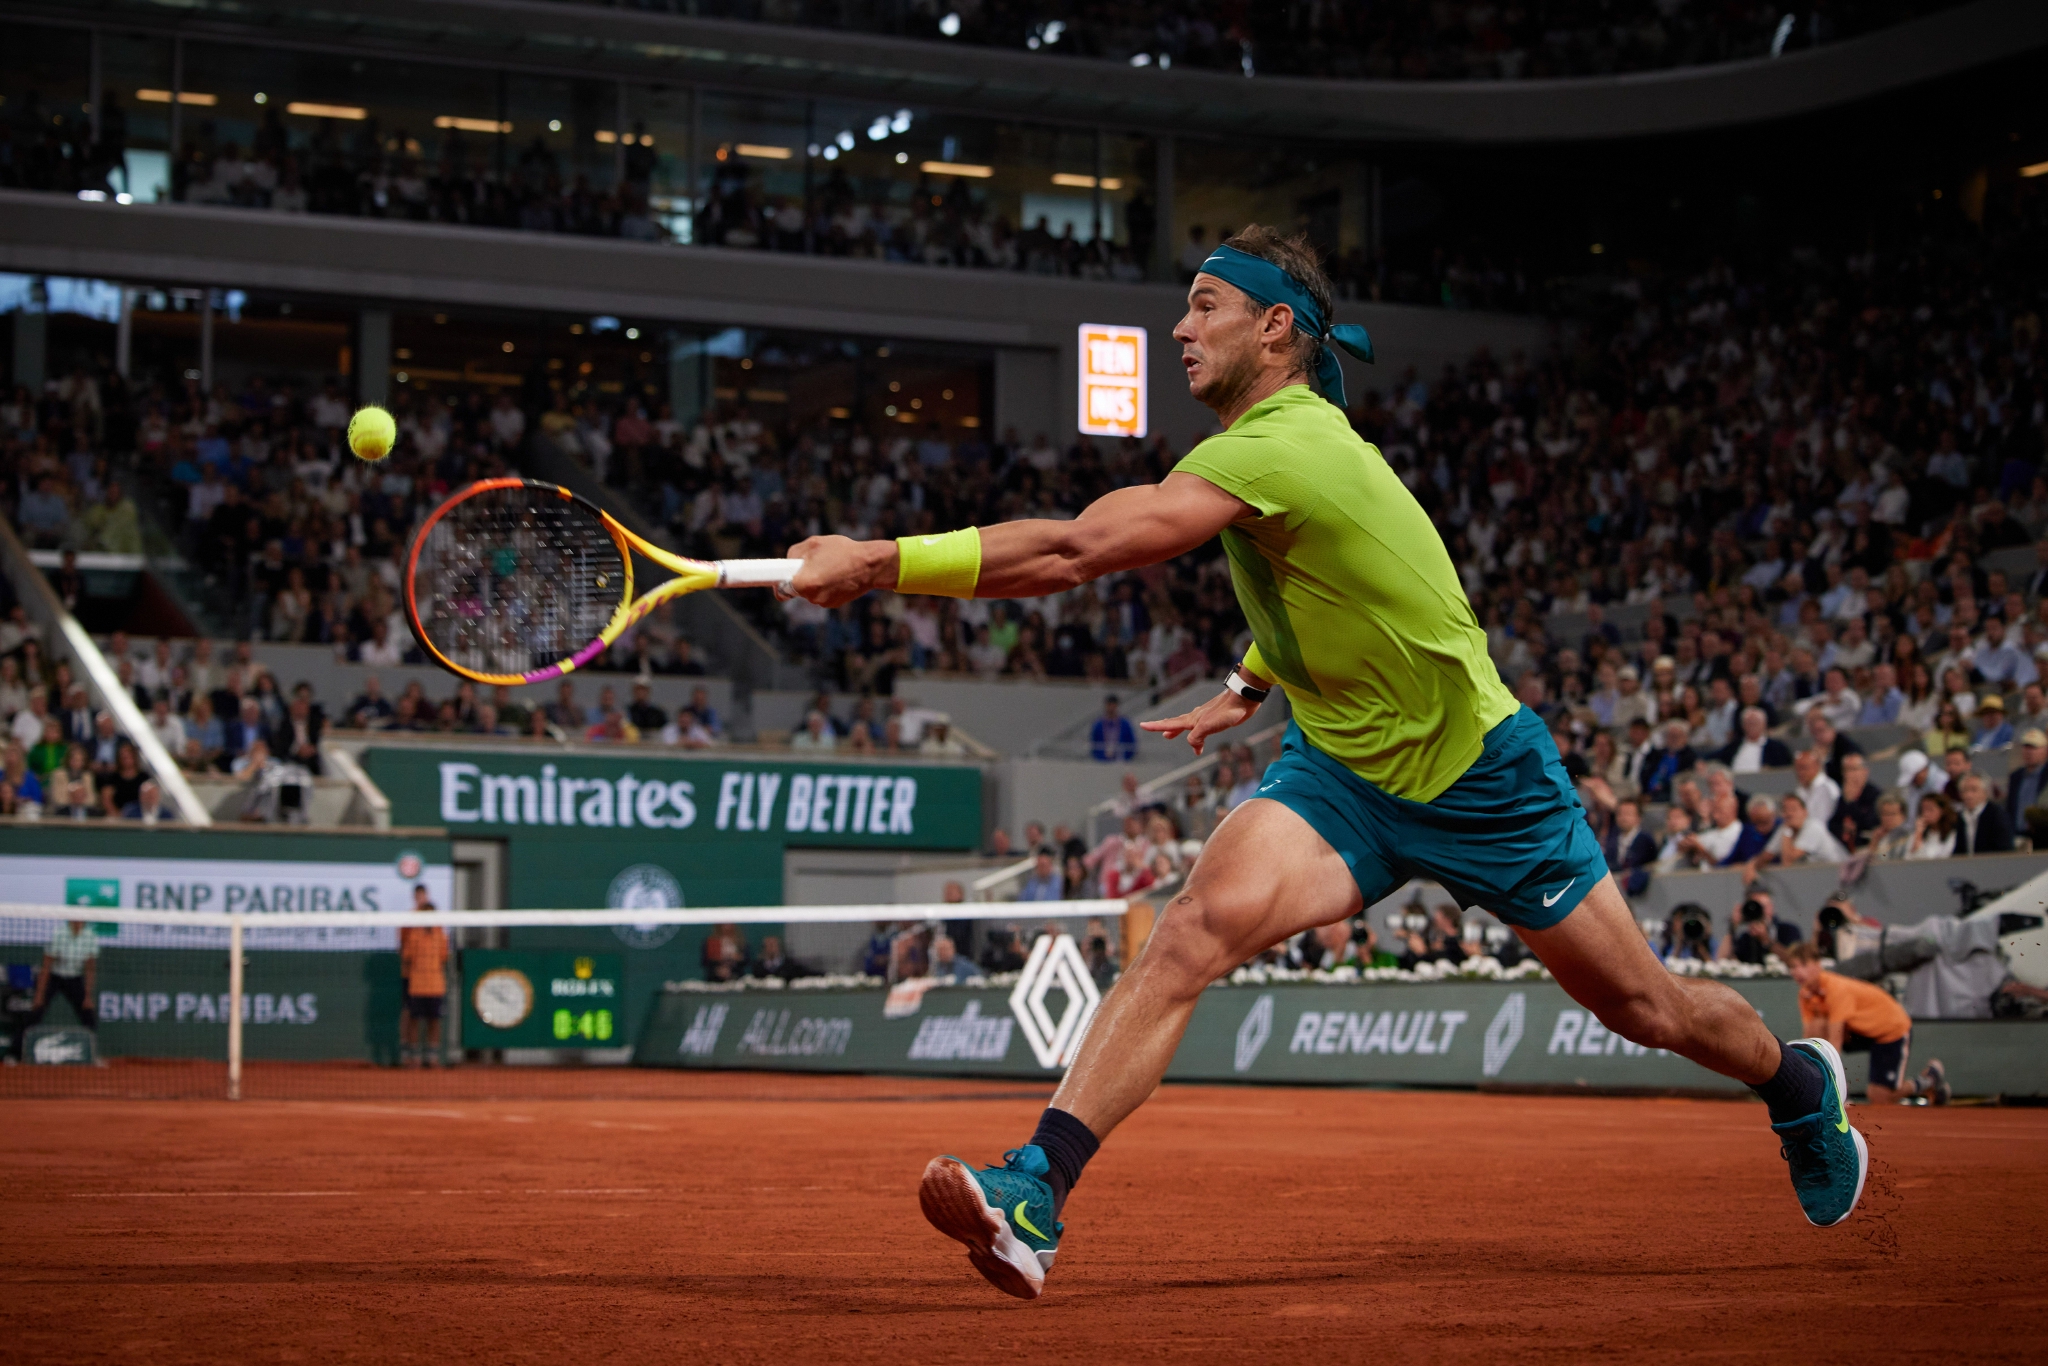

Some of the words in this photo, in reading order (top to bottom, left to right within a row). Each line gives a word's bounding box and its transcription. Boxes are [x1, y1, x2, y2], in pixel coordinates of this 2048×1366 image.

[439, 762, 697, 829] Emirates
[715, 771, 782, 830] FLY
[785, 773, 917, 834] BETTER
[135, 881, 213, 911] BNP
[223, 883, 380, 913] PARIBAS
[98, 991, 169, 1023] BNP
[1289, 1010, 1468, 1055] RENAULT
